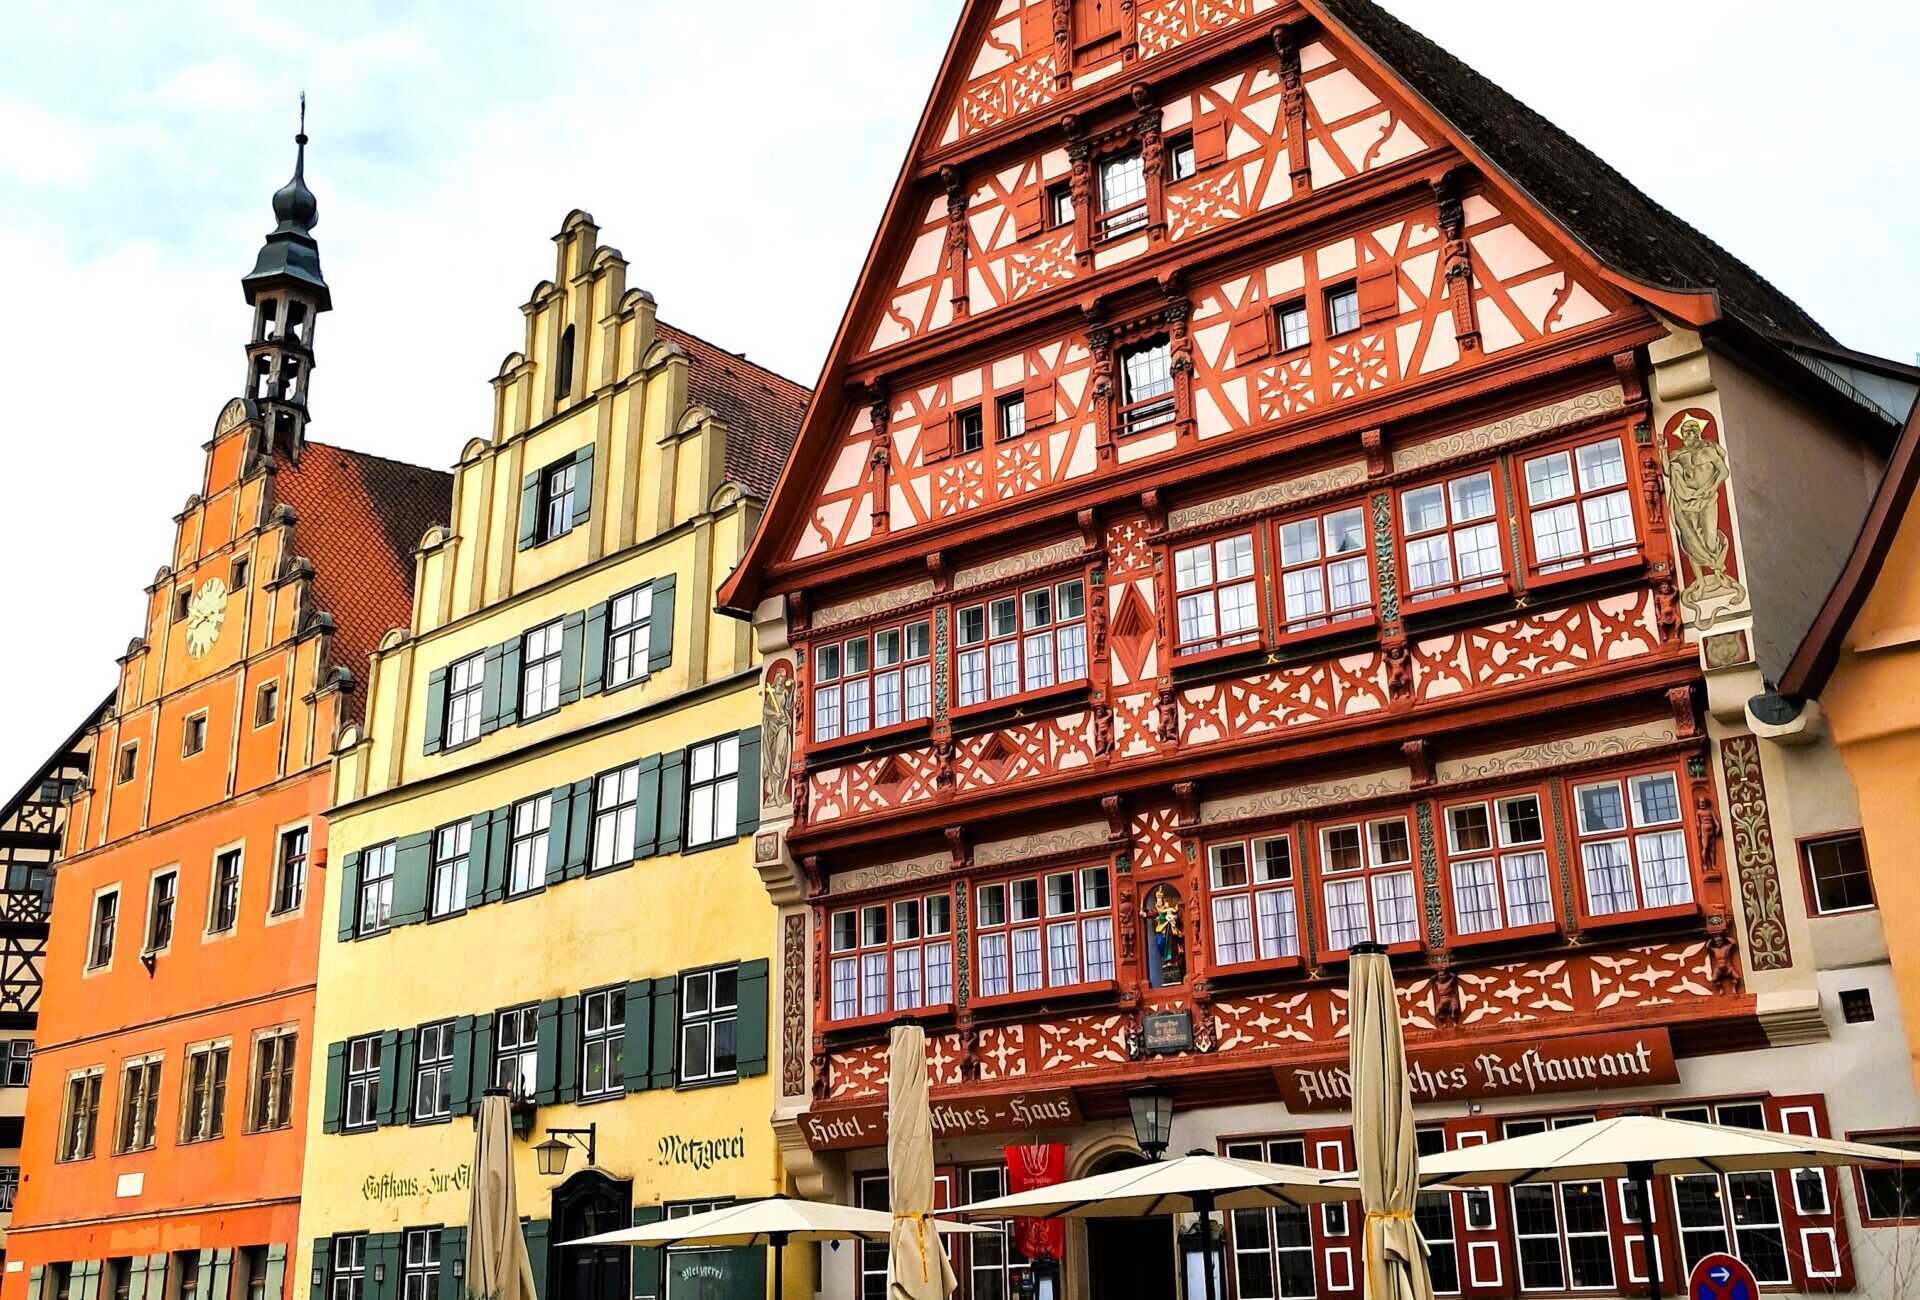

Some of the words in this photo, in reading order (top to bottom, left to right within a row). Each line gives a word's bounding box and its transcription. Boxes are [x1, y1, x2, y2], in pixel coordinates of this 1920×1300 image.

[1291, 1060, 1468, 1107] Altdches
[1474, 1040, 1652, 1093] Restaurant
[808, 1114, 865, 1145] Hotel
[1009, 1095, 1072, 1128] Haus
[657, 1127, 745, 1171] Metzgerei
[361, 1171, 419, 1203] Gasthaus
